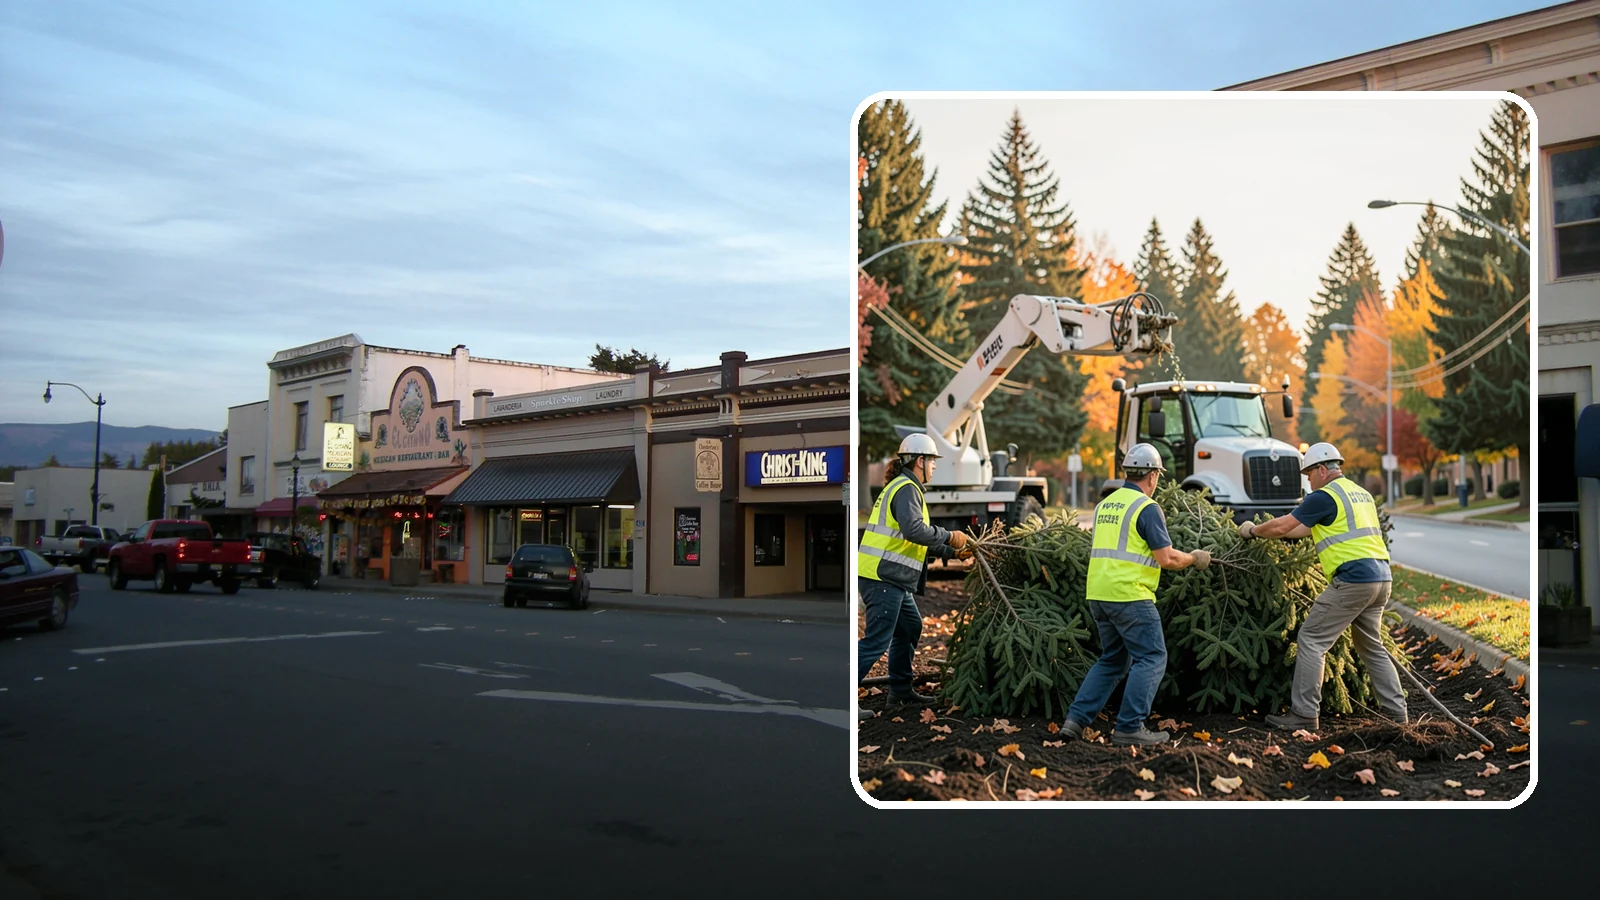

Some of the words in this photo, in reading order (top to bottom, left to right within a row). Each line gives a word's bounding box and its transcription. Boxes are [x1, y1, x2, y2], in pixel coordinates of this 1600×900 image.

[595, 389, 624, 399] LAUNDRY
[493, 402, 523, 412] LAVANDERIA
[530, 396, 561, 409] Sparkle
[561, 395, 582, 405] Shop
[397, 451, 434, 462] RESTAURANT
[437, 450, 450, 459] BAR
[761, 452, 797, 478] CHRIST
[799, 450, 827, 477] KING
